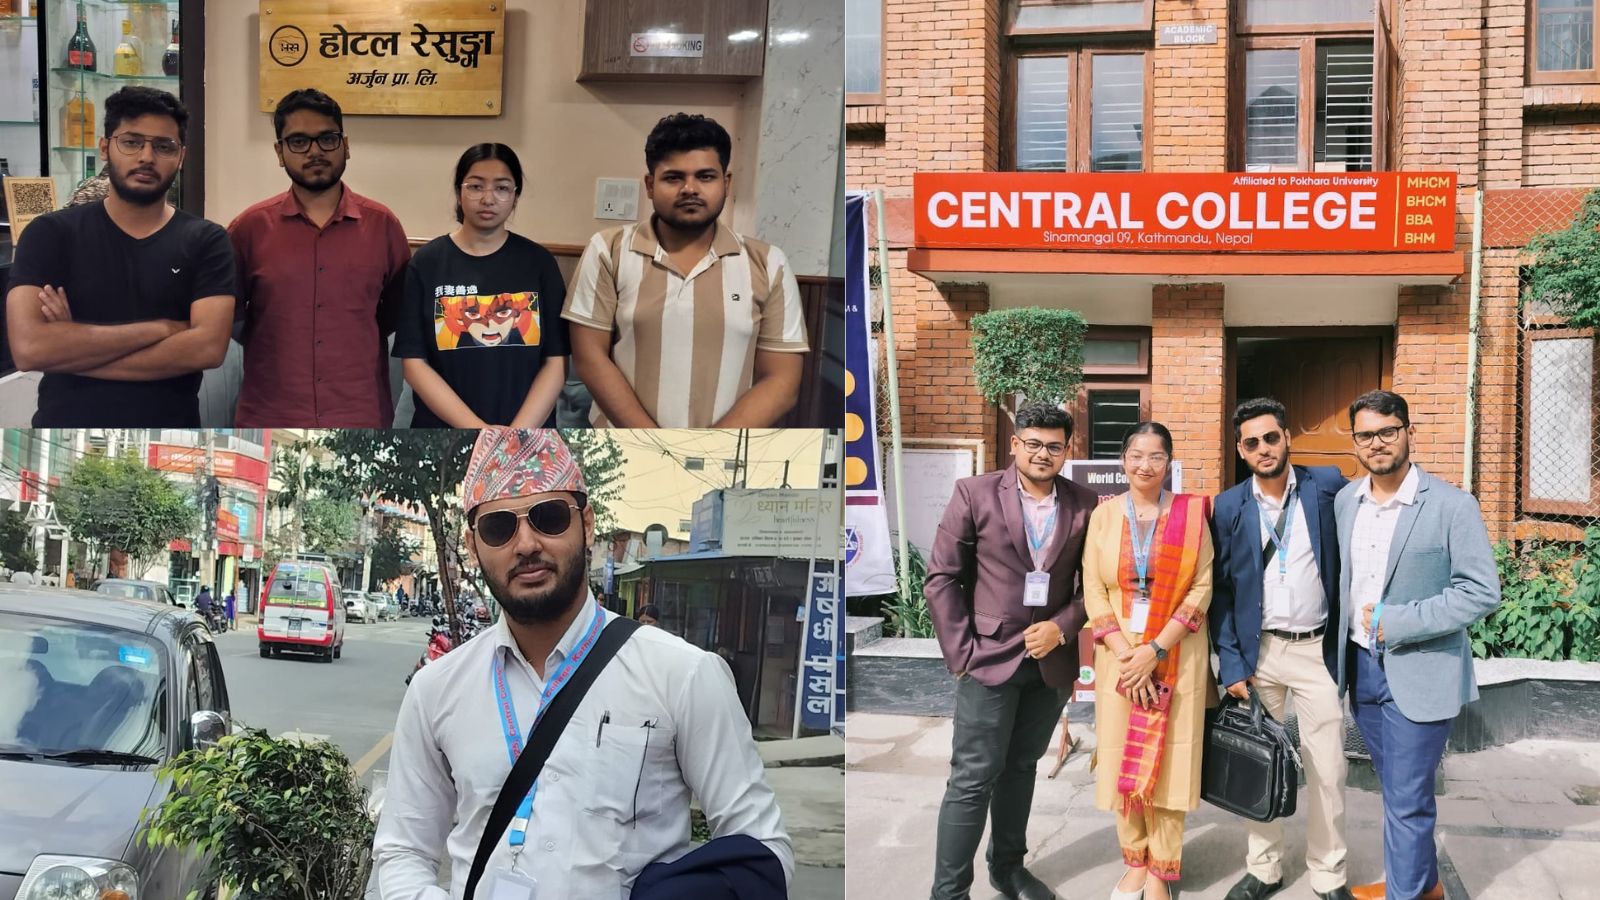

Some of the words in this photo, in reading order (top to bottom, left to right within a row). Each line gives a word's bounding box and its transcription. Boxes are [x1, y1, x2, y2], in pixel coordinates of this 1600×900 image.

[1164, 25, 1213, 34] ACADEMIC
[319, 24, 401, 59] होटल
[1173, 34, 1206, 43] BLOCK
[346, 69, 389, 88] अर्जुन
[391, 72, 409, 87] प्रा.
[415, 68, 438, 86] लि.
[1233, 176, 1275, 186] Affiliated
[1277, 176, 1286, 186] to
[1290, 176, 1330, 186] Pokhara
[1332, 176, 1379, 188] University
[1407, 176, 1450, 188] MHCM
[1406, 195, 1446, 207] BHCM
[927, 191, 1144, 229] CENTRAL
[1156, 191, 1377, 230] COLLEGE
[1405, 214, 1433, 226] BBA
[1043, 231, 1114, 246] Sinamangal
[1116, 231, 1135, 245] 09,
[1138, 231, 1212, 245] Kathmandu,
[1215, 232, 1253, 246] Nepal
[1404, 232, 1435, 244] BHM
[1087, 472, 1114, 484] World
[546, 665, 573, 698] College
